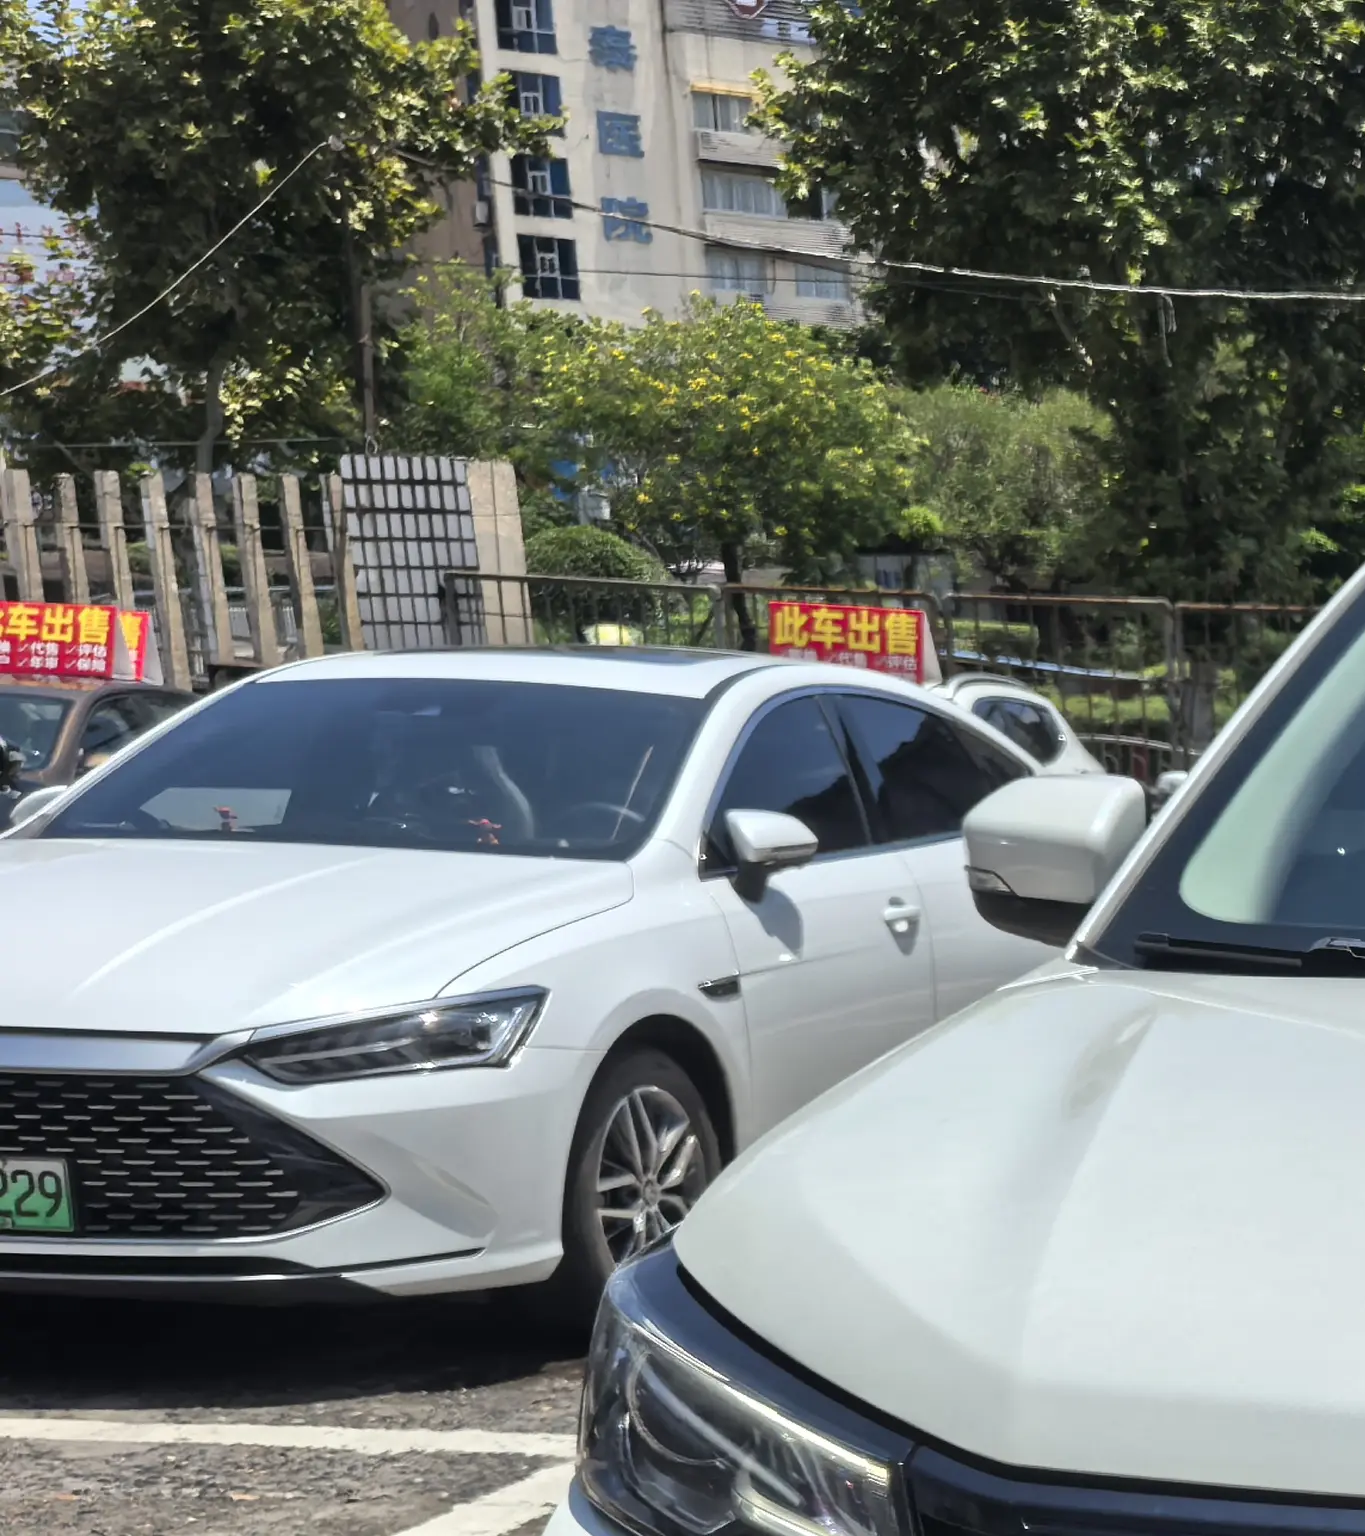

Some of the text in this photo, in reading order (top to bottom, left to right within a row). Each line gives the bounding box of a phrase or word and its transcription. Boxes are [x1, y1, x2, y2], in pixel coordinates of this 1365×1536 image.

[0, 603, 111, 645] 车出售
[774, 605, 918, 656] 此车出售
